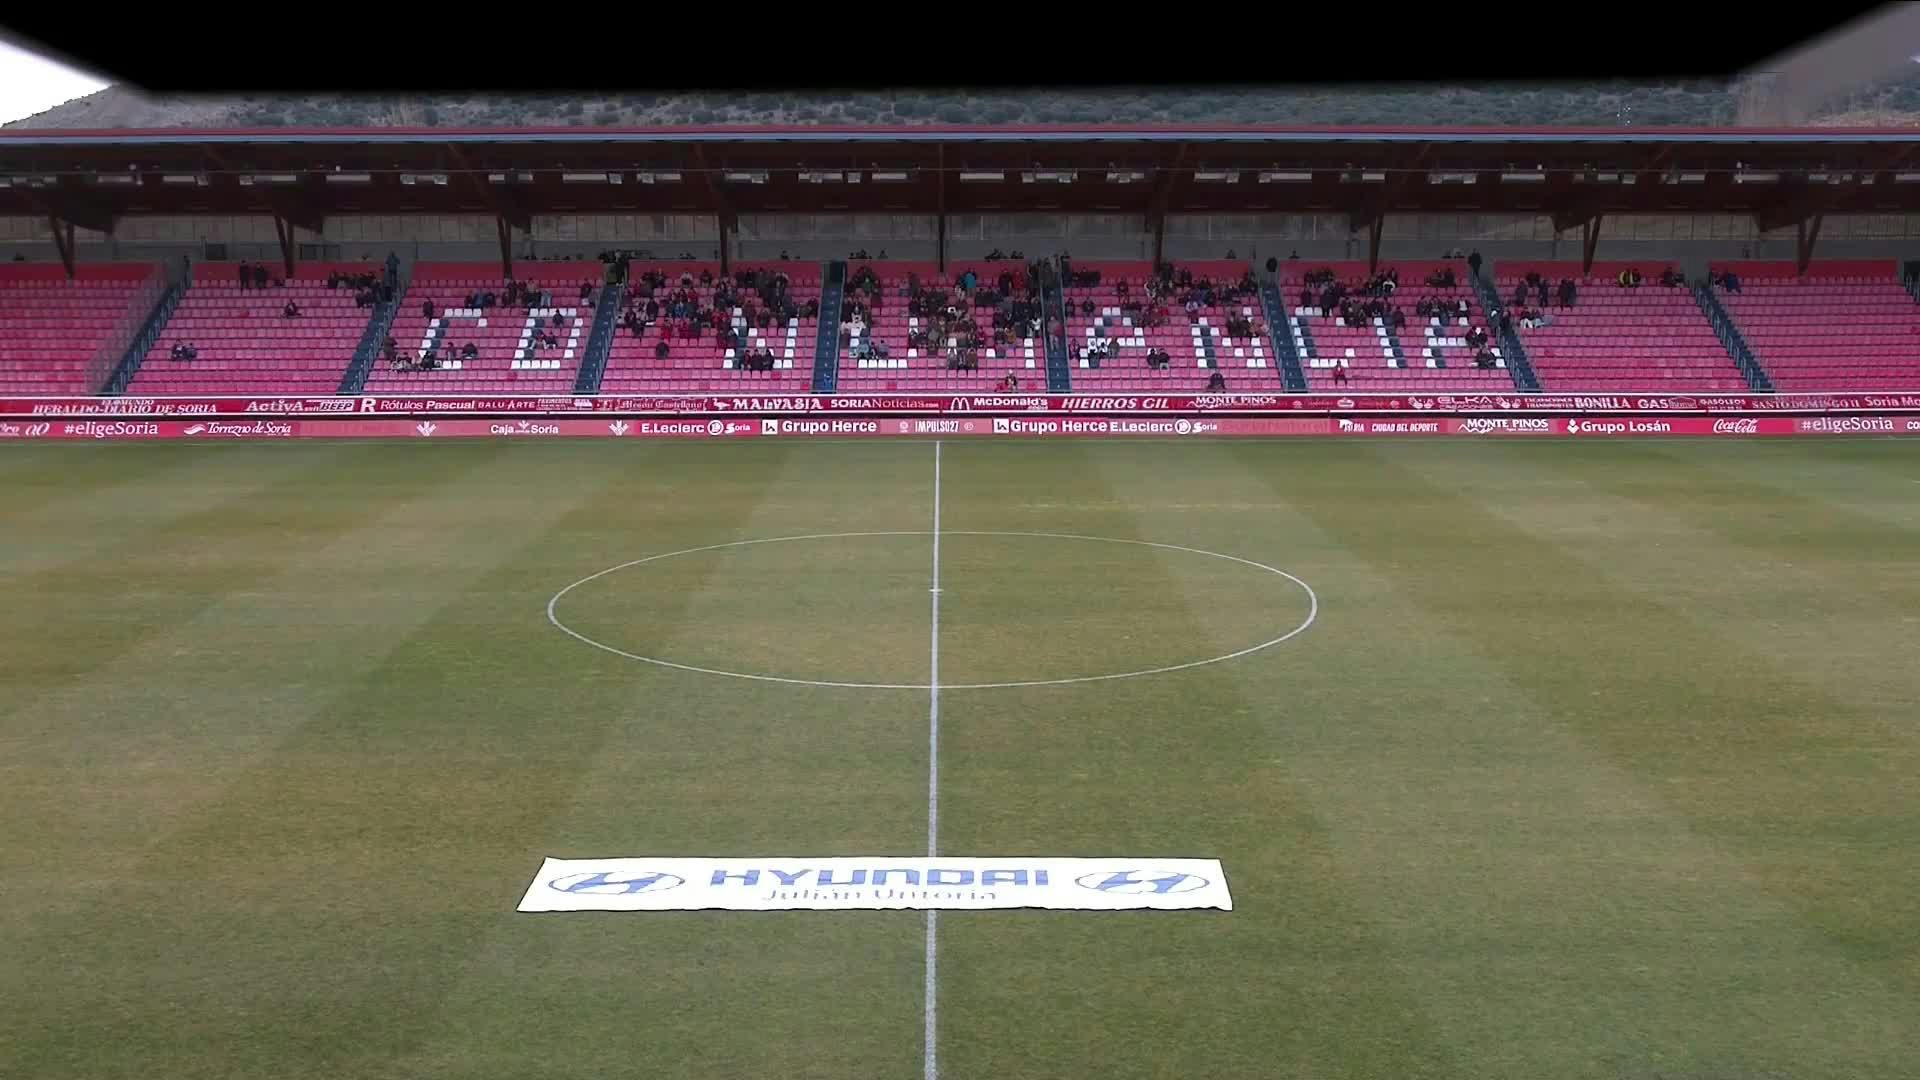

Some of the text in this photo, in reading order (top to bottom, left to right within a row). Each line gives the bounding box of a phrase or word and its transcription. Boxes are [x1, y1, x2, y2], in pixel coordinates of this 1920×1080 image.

[361, 398, 376, 412] R
[381, 399, 474, 410] Rótulos Pascual
[733, 398, 823, 410] MALVASIA
[974, 397, 1048, 406] McDonald's
[1061, 398, 1136, 409] HIERROS
[1142, 398, 1169, 409] GIL
[1196, 396, 1277, 404] MONTE PINOS
[1574, 397, 1631, 409] BONILLA
[1637, 399, 1669, 409] GAS
[1865, 396, 1899, 407] Soria
[155, 404, 174, 413] DE
[177, 404, 216, 413] SORIA
[321, 402, 352, 410] BEEP
[64, 421, 158, 437] #eligeSoria
[208, 421, 291, 436] Torrezno de Soria
[641, 423, 751, 434] E.Leclerc Soria
[782, 420, 877, 434] Grupo Herce
[915, 420, 959, 432] IMPULSO27
[1011, 420, 1107, 434] Grupo Herce
[1110, 421, 1173, 432] E.Leclerc
[1192, 421, 1217, 433] Soria
[1371, 423, 1395, 432] CIUDAD
[1396, 423, 1409, 432] DEL
[1410, 423, 1438, 432] DEPORTE
[1467, 419, 1548, 428] MONTE PINOS
[1581, 420, 1670, 434] Grupo Losán
[1801, 417, 1894, 433] #eligeSoria
[491, 424, 559, 435] Caja Soria
[710, 869, 1048, 886] HYUNDAI
